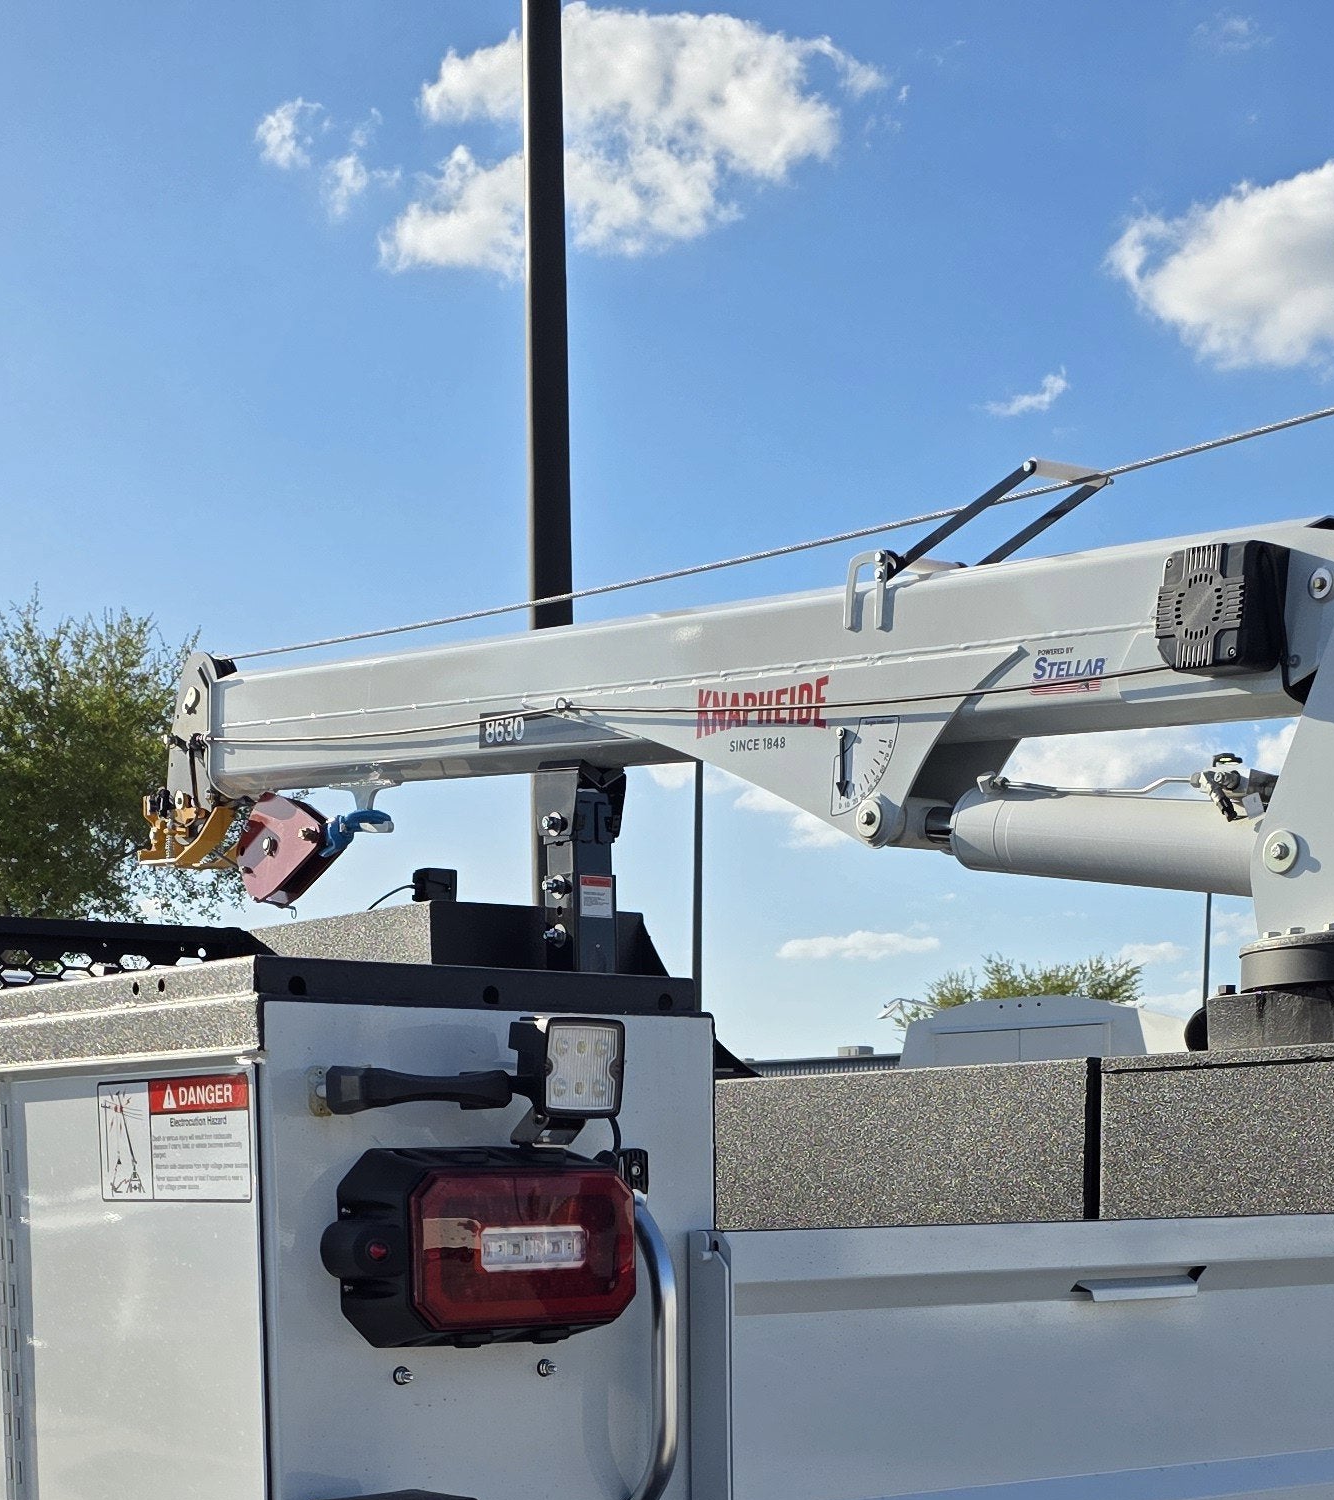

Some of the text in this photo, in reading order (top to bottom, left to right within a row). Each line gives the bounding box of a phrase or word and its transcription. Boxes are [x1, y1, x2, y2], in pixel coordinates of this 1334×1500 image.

[1038, 646, 1074, 656] POWERED BY
[1033, 656, 1107, 679] STELLAR
[696, 675, 830, 739] KNAPHEIDE
[485, 716, 525, 744] 8630
[729, 737, 787, 752] SINCE 1848
[178, 1083, 233, 1106] DANGER
[169, 1114, 227, 1128] Electrocution Hazard
